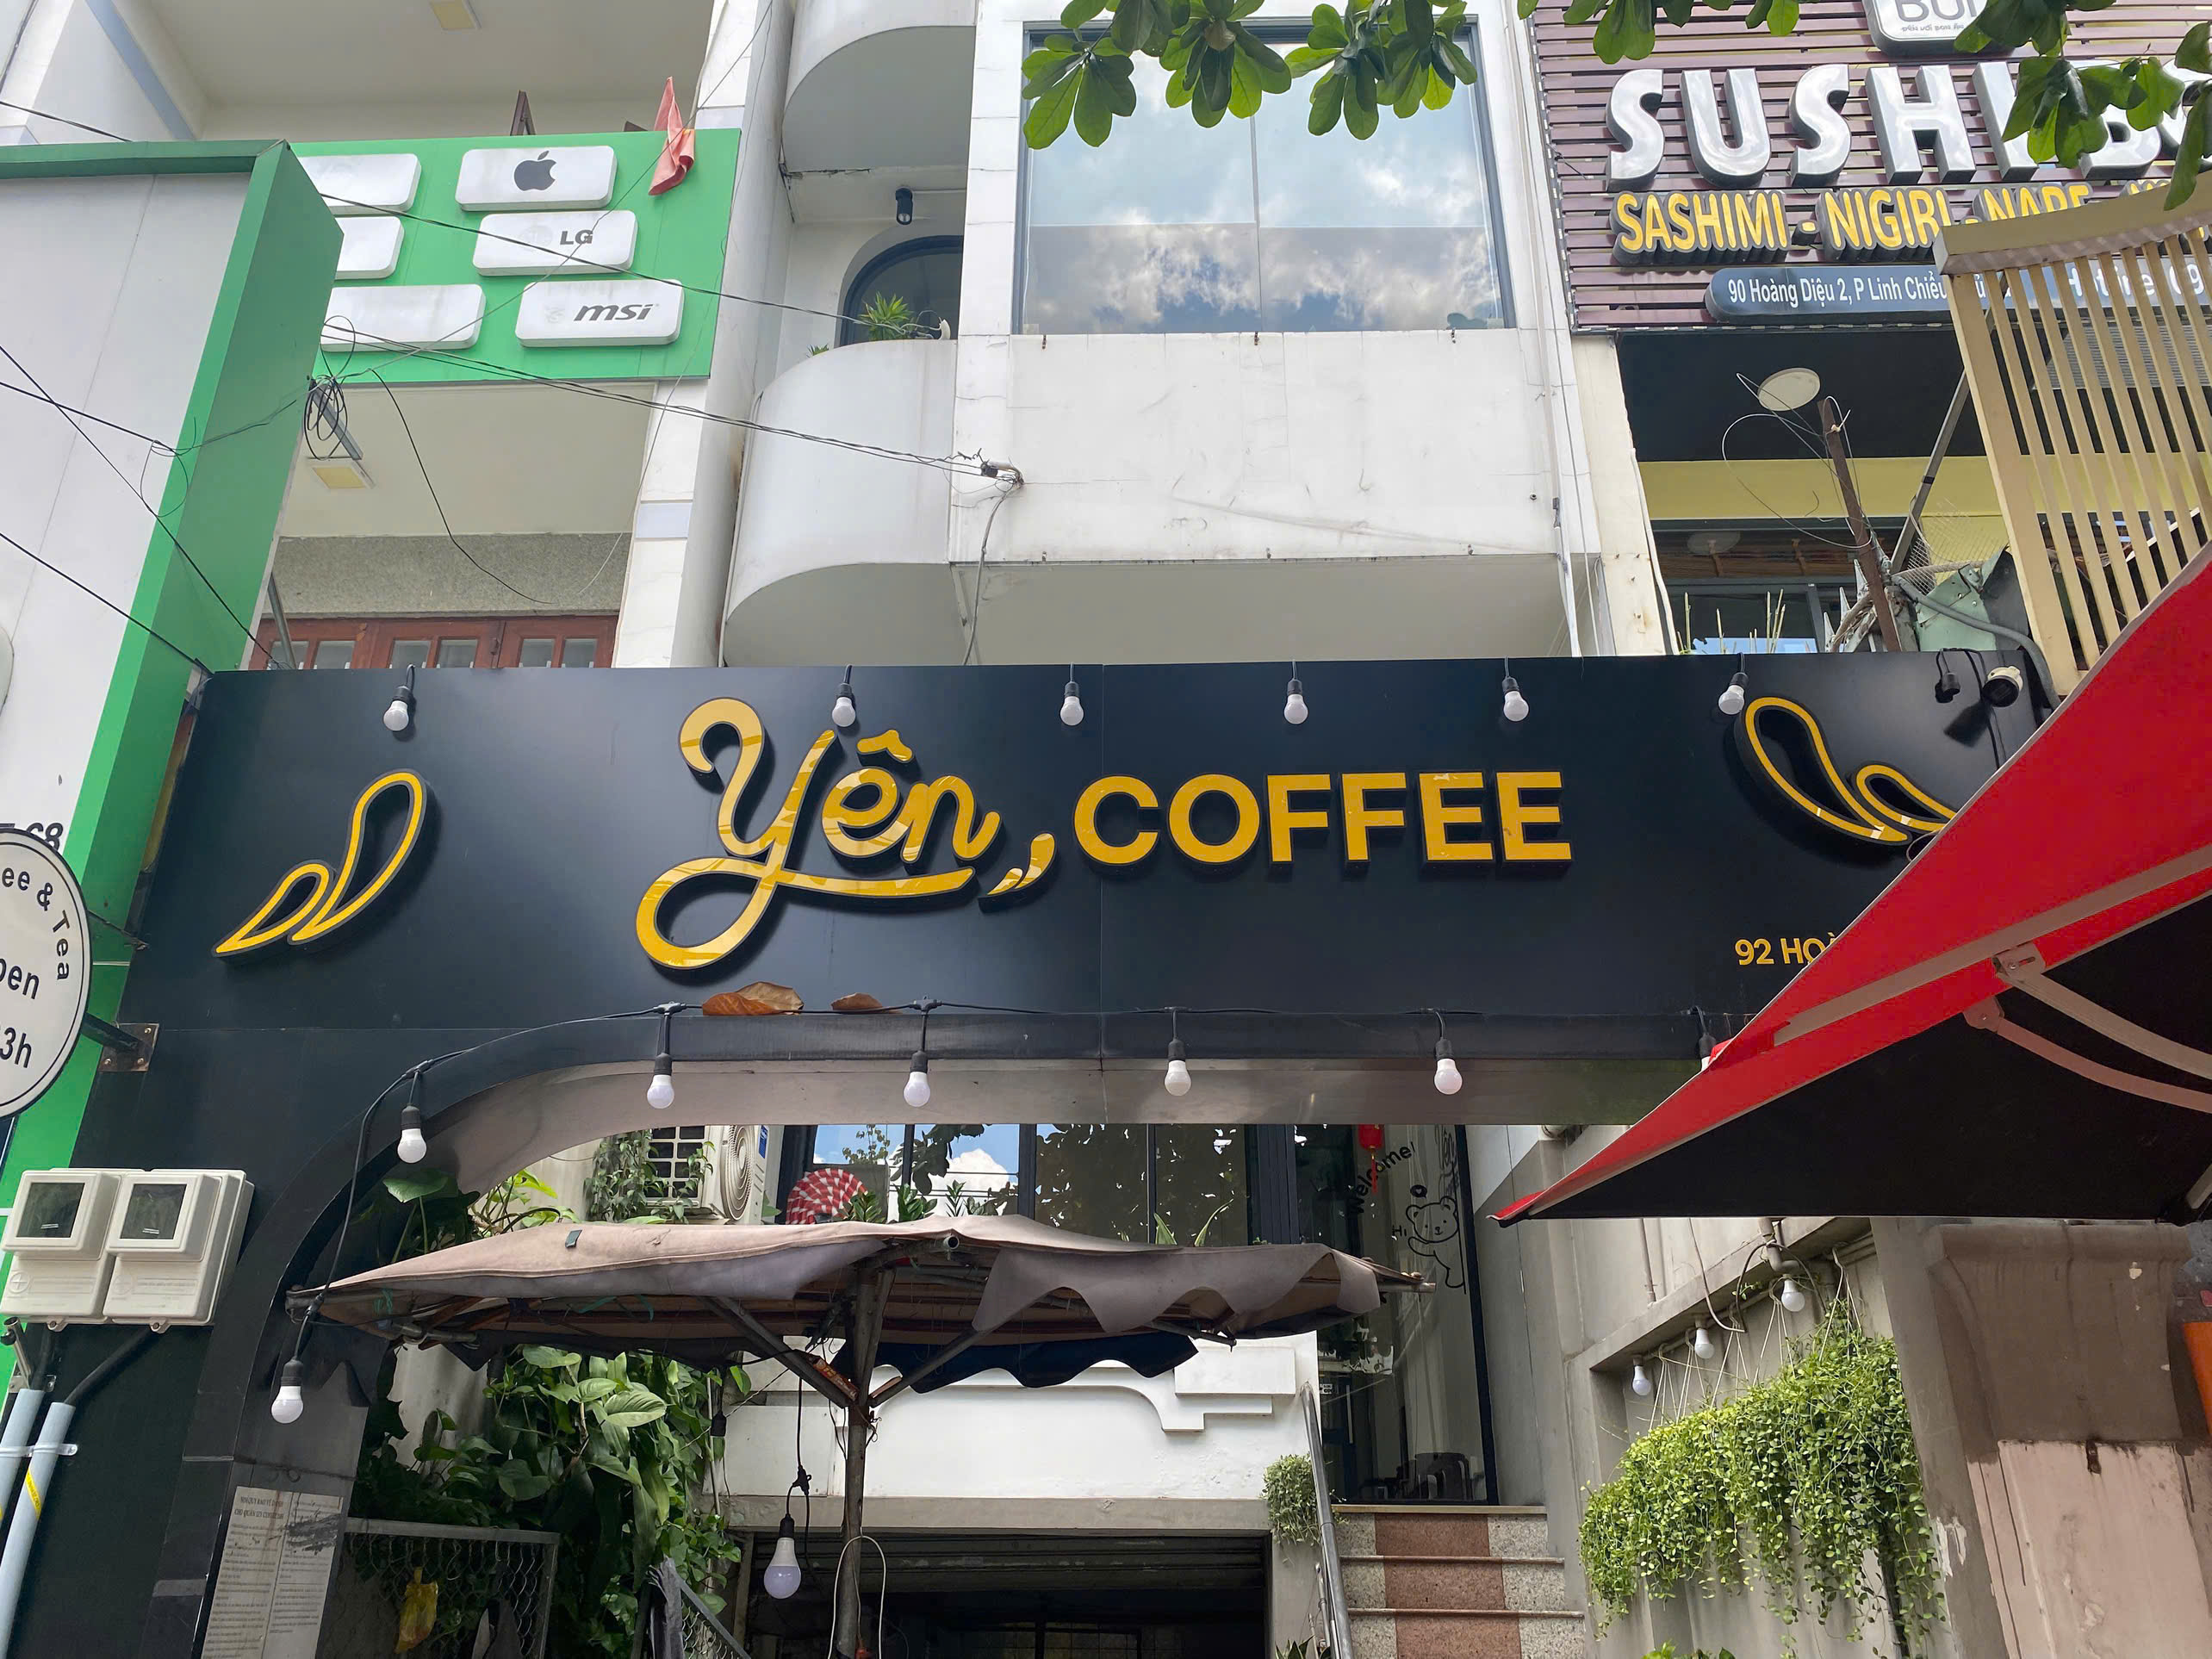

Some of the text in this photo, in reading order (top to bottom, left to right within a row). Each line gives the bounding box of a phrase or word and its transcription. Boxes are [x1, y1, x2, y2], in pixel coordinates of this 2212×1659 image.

[1607, 61, 2038, 183] SUSHI
[559, 228, 594, 245] LG
[1615, 191, 1788, 251] SASHIMI
[1823, 190, 1952, 249] NIGIRI
[573, 303, 655, 321] msi
[1728, 278, 1746, 303] 90
[1749, 277, 1799, 308] Hoàng
[1799, 277, 1836, 308] Diệu
[1853, 276, 1865, 301] P
[1867, 275, 1903, 301] Linh
[1072, 771, 1573, 865] COFFEE
[52, 910, 71, 981] Tea
[1734, 937, 1775, 966] 92
